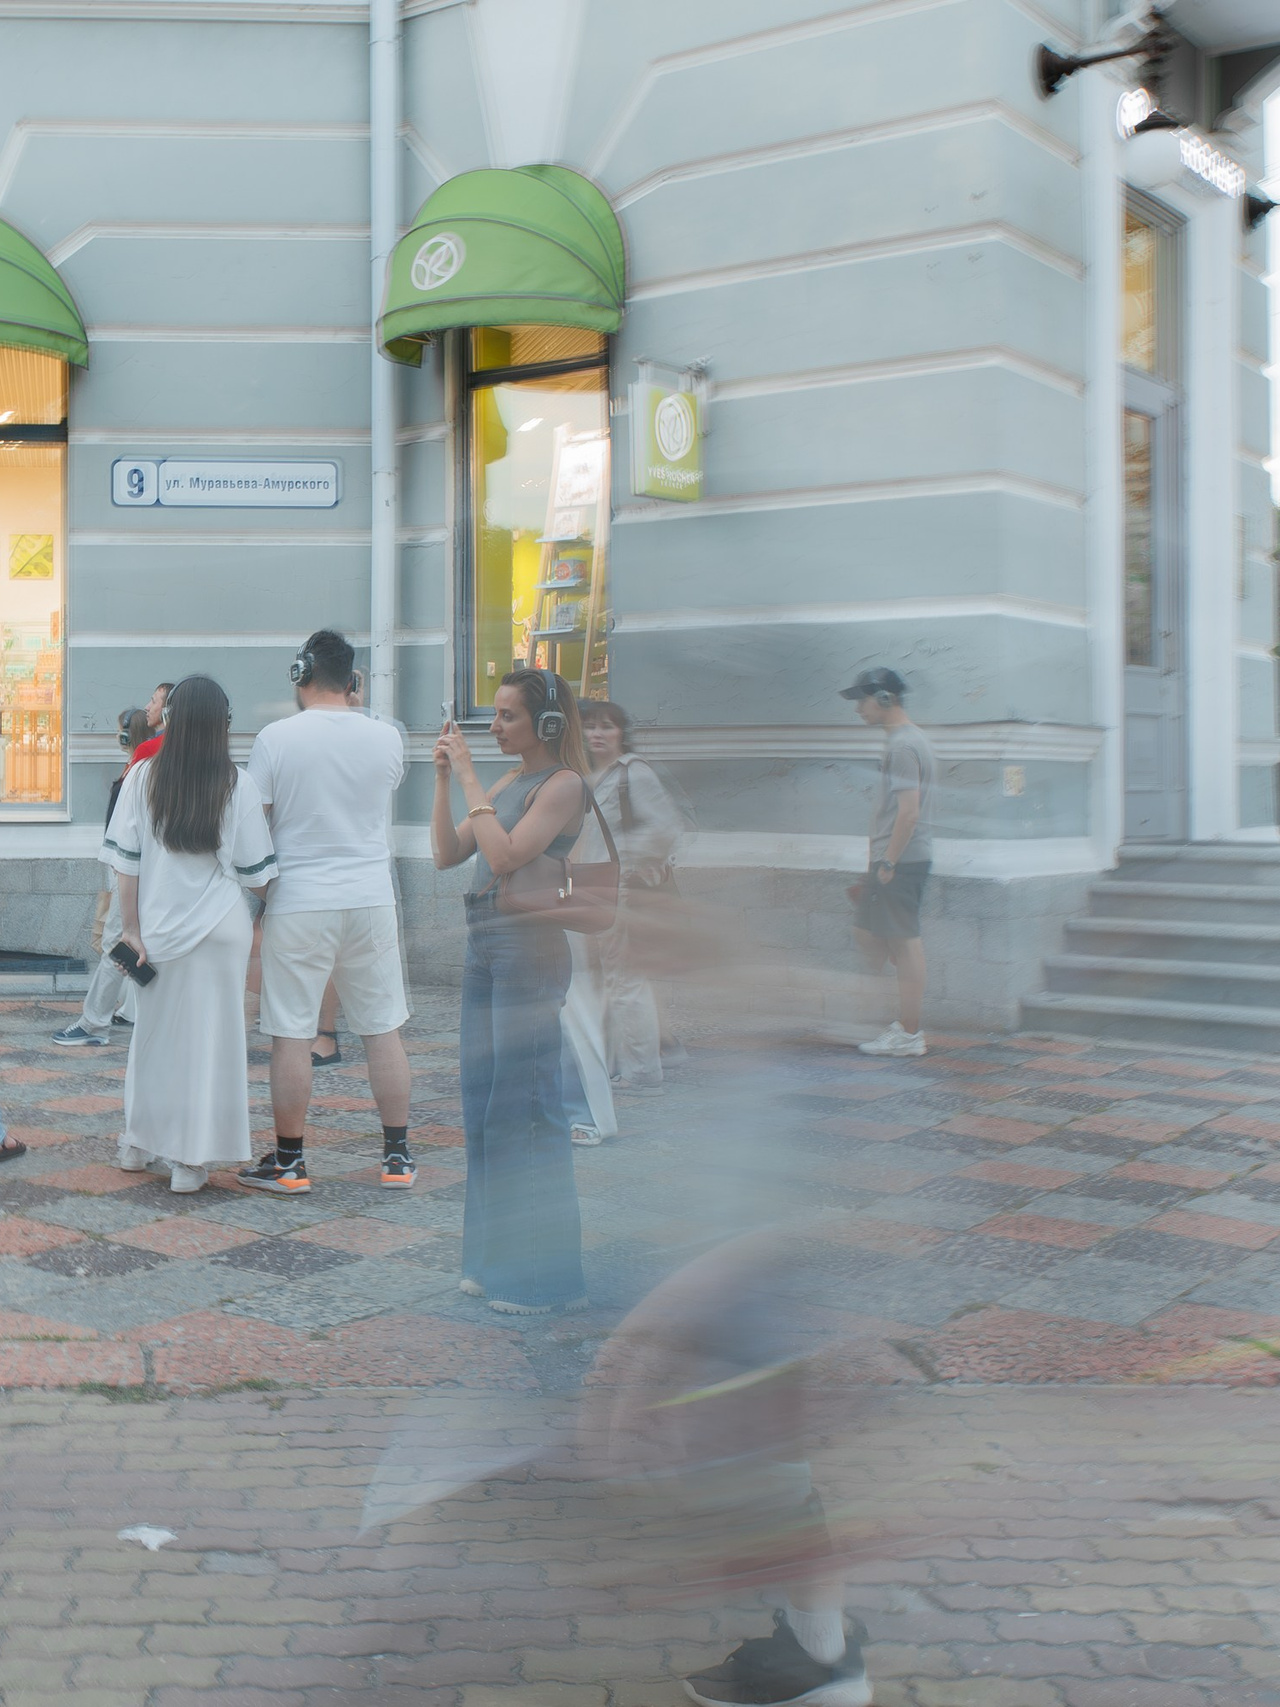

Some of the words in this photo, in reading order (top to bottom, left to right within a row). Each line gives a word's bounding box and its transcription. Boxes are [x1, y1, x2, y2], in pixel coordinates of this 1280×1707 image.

[126, 468, 144, 499] 9
[165, 479, 184, 491] ул.
[189, 477, 330, 492] Муравьева-Амурского
